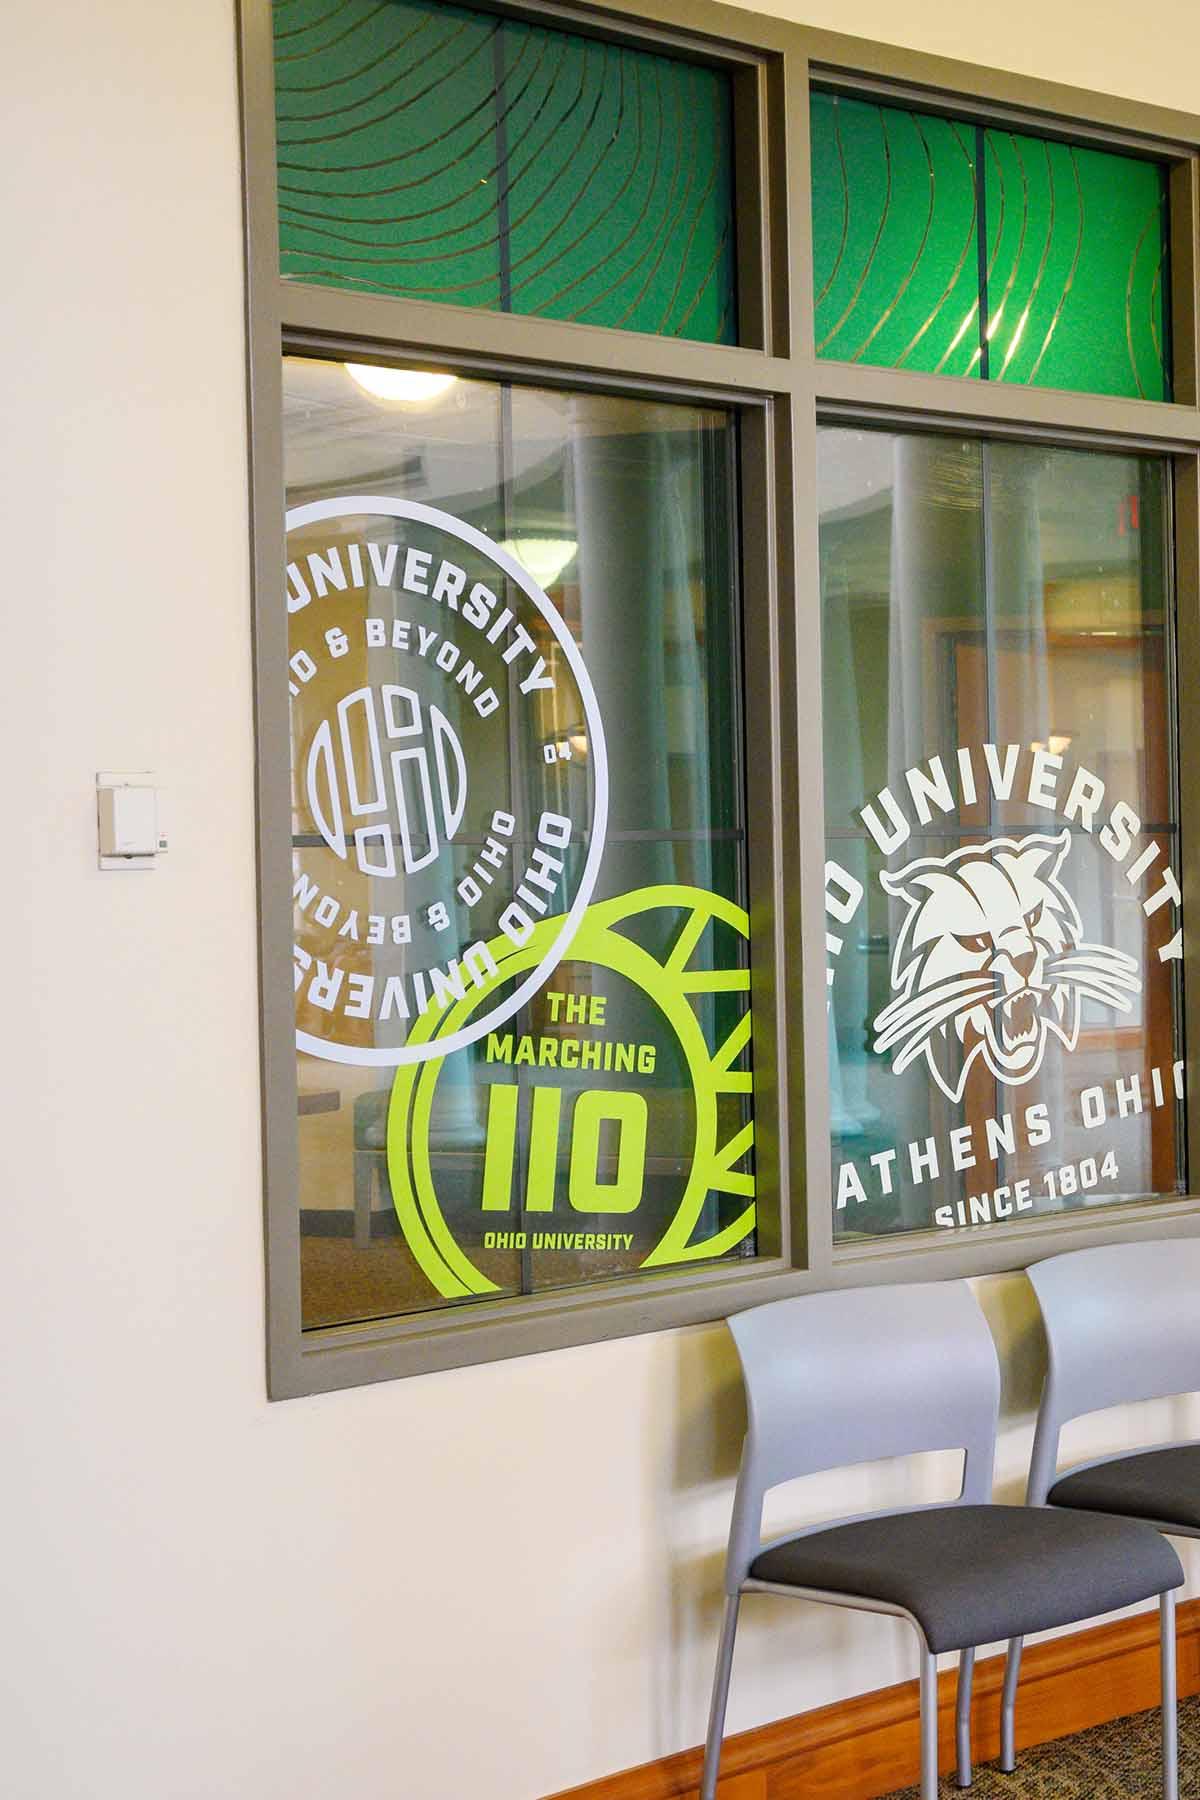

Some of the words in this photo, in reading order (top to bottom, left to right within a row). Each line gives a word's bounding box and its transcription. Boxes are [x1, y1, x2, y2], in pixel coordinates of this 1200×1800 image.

[365, 618, 500, 718] BEYOND
[457, 810, 516, 907] OHIO
[498, 811, 573, 947] OHIO
[859, 743, 1183, 963] UNIVERSITY
[486, 1033, 657, 1074] MARCHING
[547, 991, 607, 1026] THE
[482, 1083, 648, 1213] 110
[836, 1103, 1052, 1210] ATHENS
[934, 1179, 1033, 1227] SINCE
[1043, 1150, 1120, 1201] 1804
[484, 1232, 527, 1249] OHIO
[532, 1232, 635, 1250] UNIVERSITY
